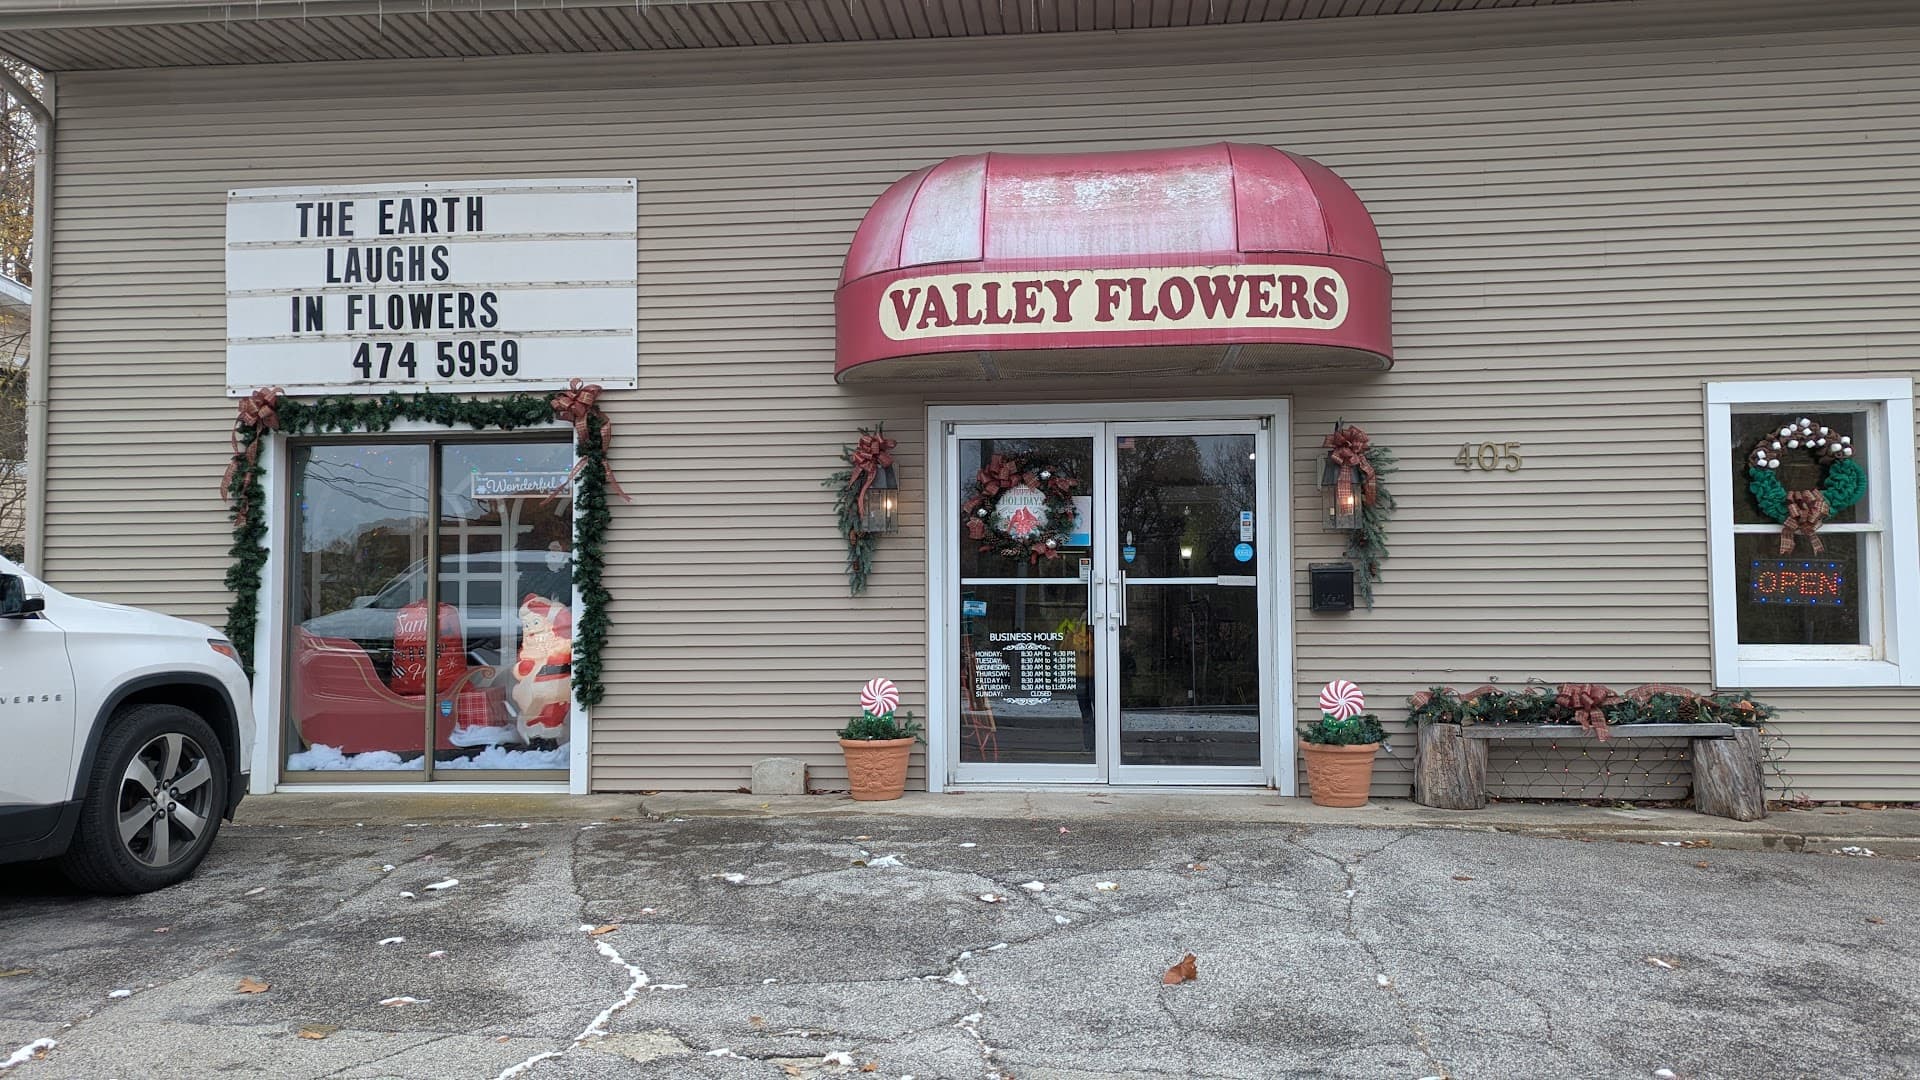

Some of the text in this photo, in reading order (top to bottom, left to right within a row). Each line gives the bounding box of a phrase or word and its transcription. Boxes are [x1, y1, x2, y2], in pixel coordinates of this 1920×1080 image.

[296, 196, 484, 238] THE EARTH
[326, 245, 450, 284] LAUGHS
[292, 291, 499, 332] IN FLOWERS
[890, 274, 1339, 331] VALLEY FLOWERS
[353, 339, 520, 379] 474 5959
[1455, 441, 1523, 472] 405
[486, 476, 558, 493] Wonderful
[1759, 571, 1839, 595] OPEN
[989, 632, 1064, 642] BUSINESS HOURS
